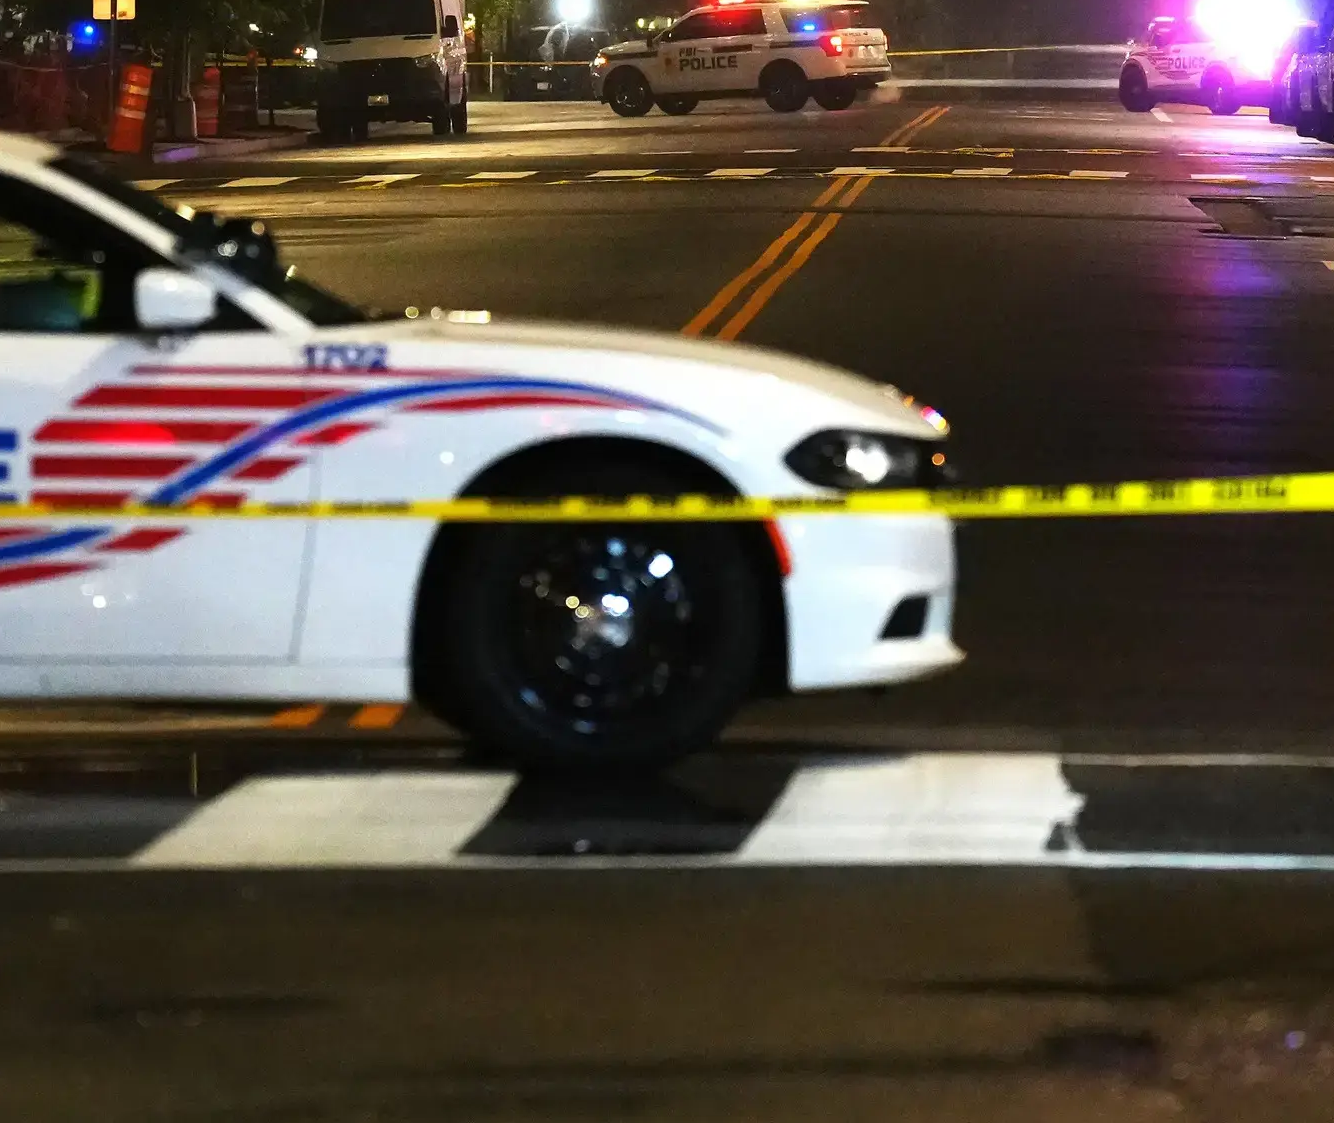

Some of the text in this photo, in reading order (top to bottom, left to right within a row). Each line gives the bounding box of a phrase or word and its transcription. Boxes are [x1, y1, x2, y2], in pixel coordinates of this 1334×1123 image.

[679, 55, 738, 71] POLICE
[1168, 56, 1206, 70] POLICE
[303, 344, 388, 371] 1702
